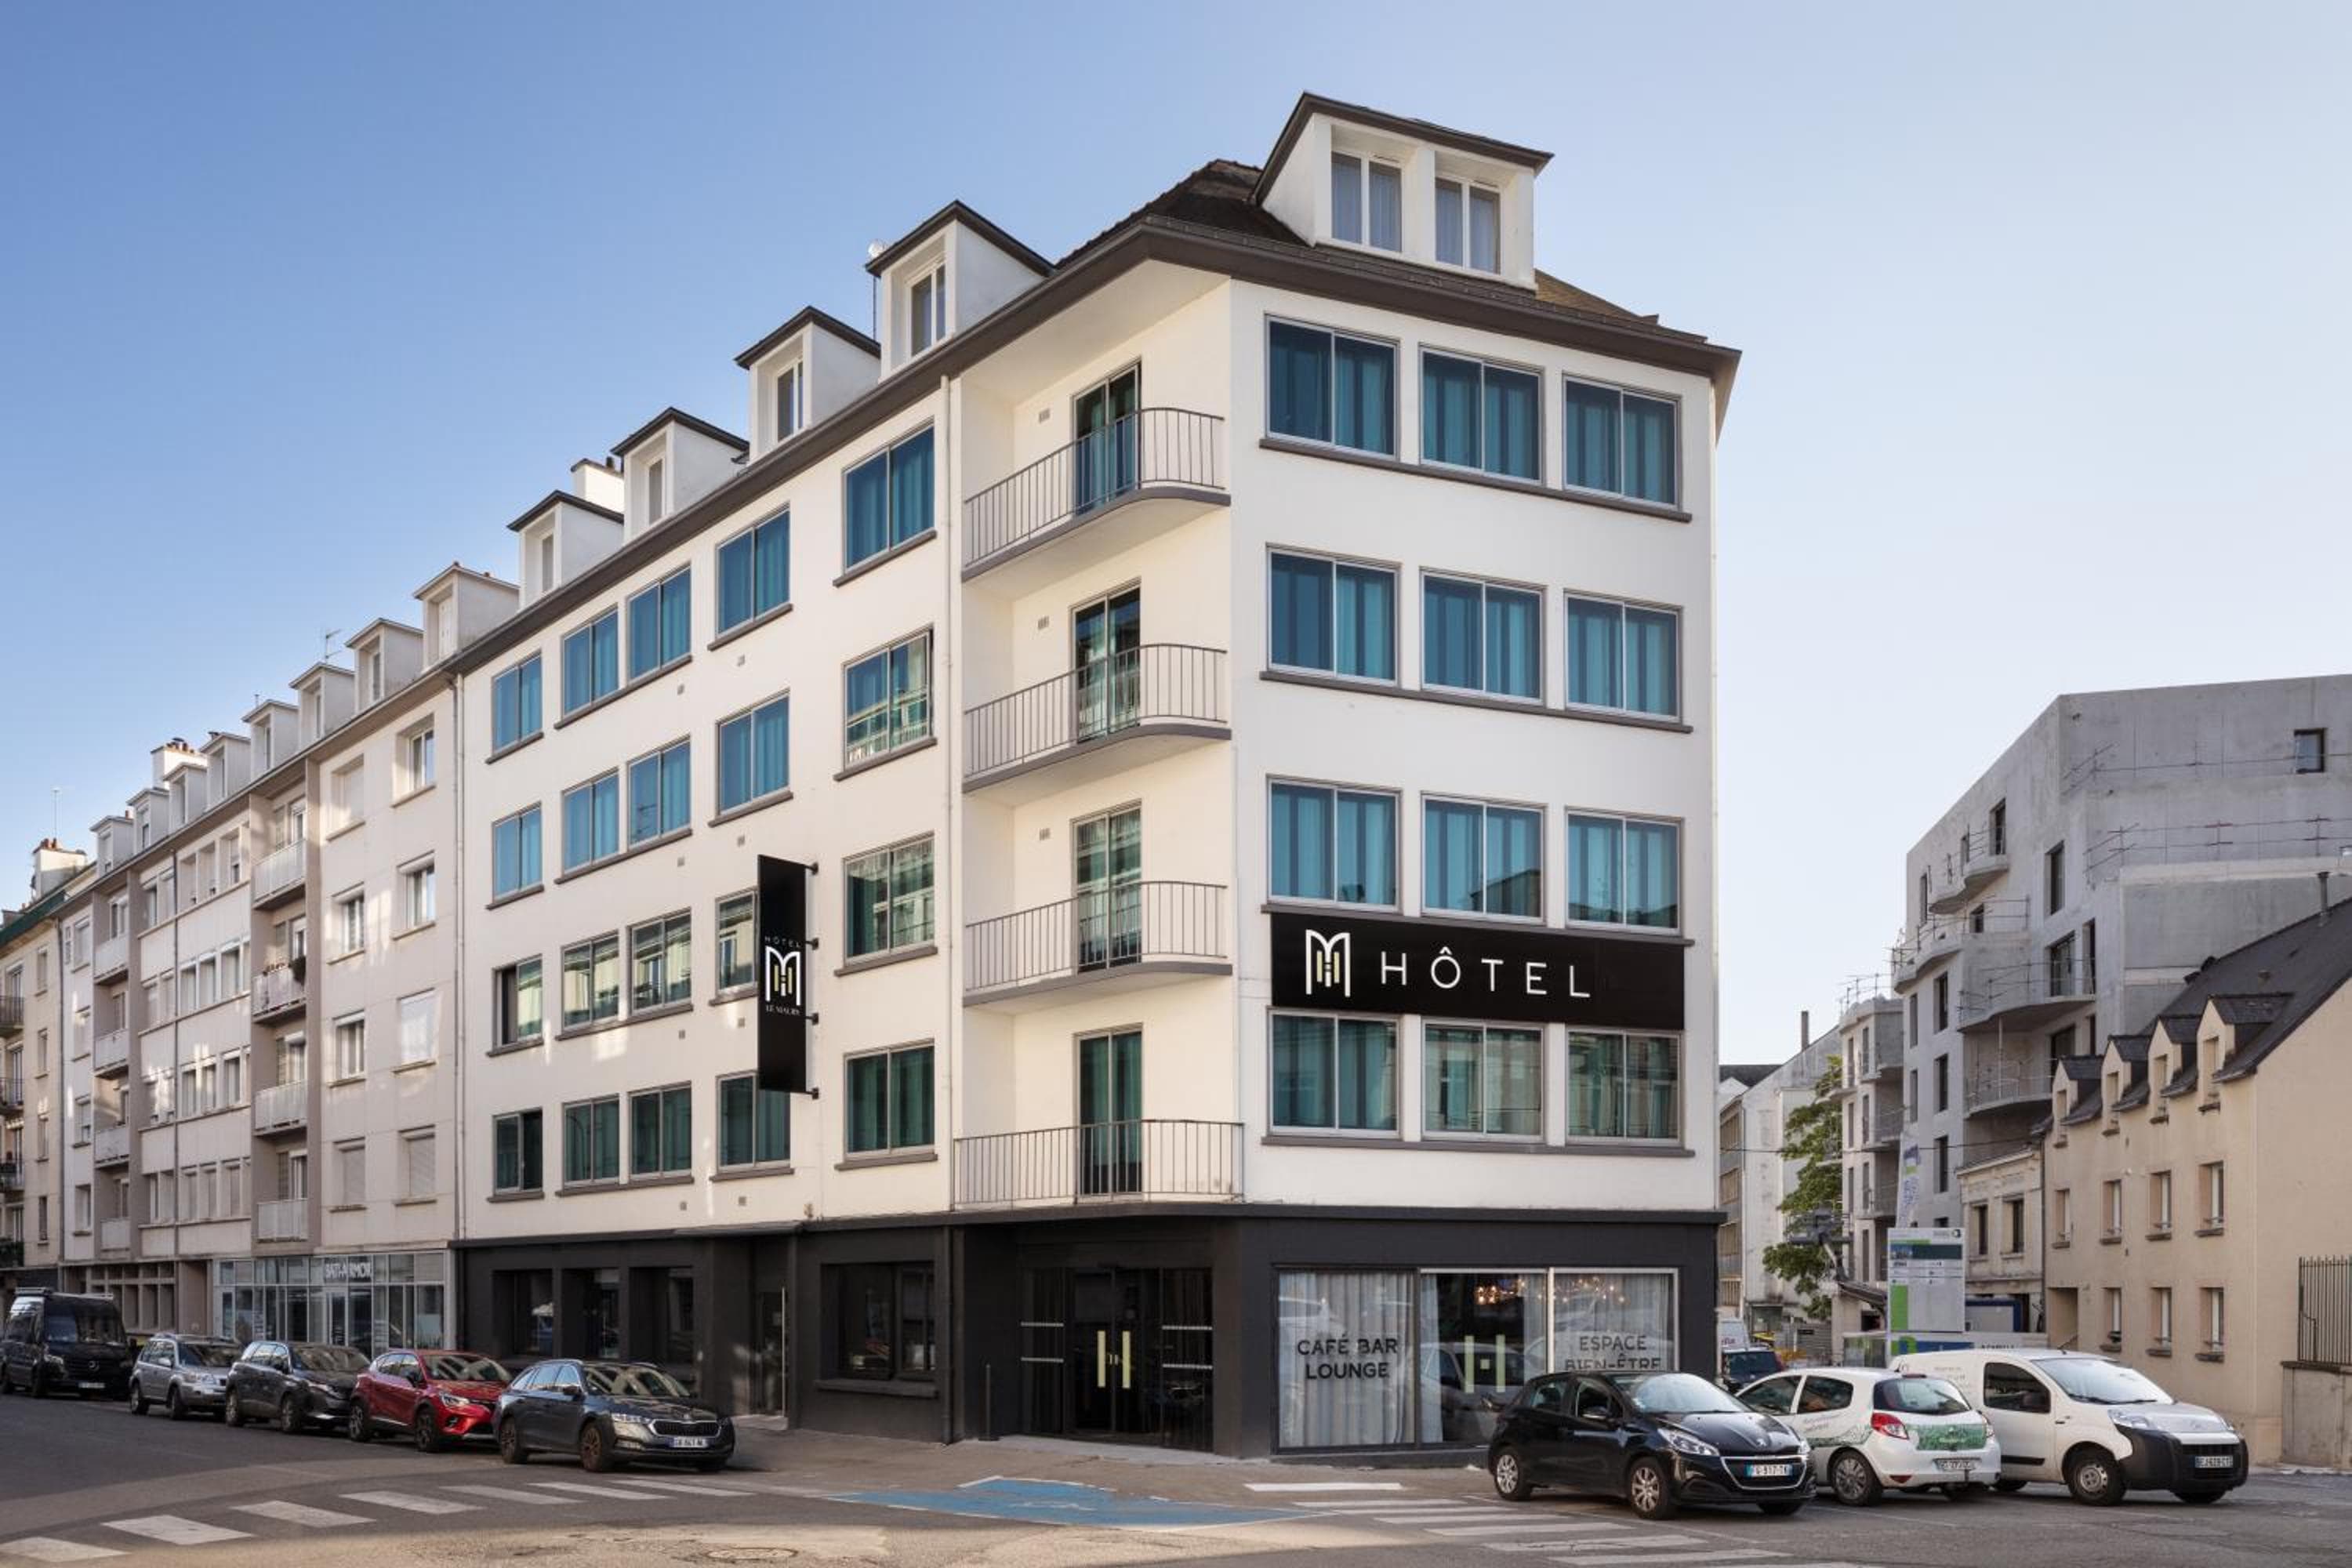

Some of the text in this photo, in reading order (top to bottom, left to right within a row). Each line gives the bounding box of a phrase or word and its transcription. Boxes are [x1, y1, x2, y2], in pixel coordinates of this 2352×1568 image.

[1381, 946, 1591, 998] HÔTEL
[1297, 1331, 1398, 1356] CAFÉ BAR
[1579, 1334, 1647, 1351] ESPACE
[1305, 1363, 1390, 1380] LOUNGE
